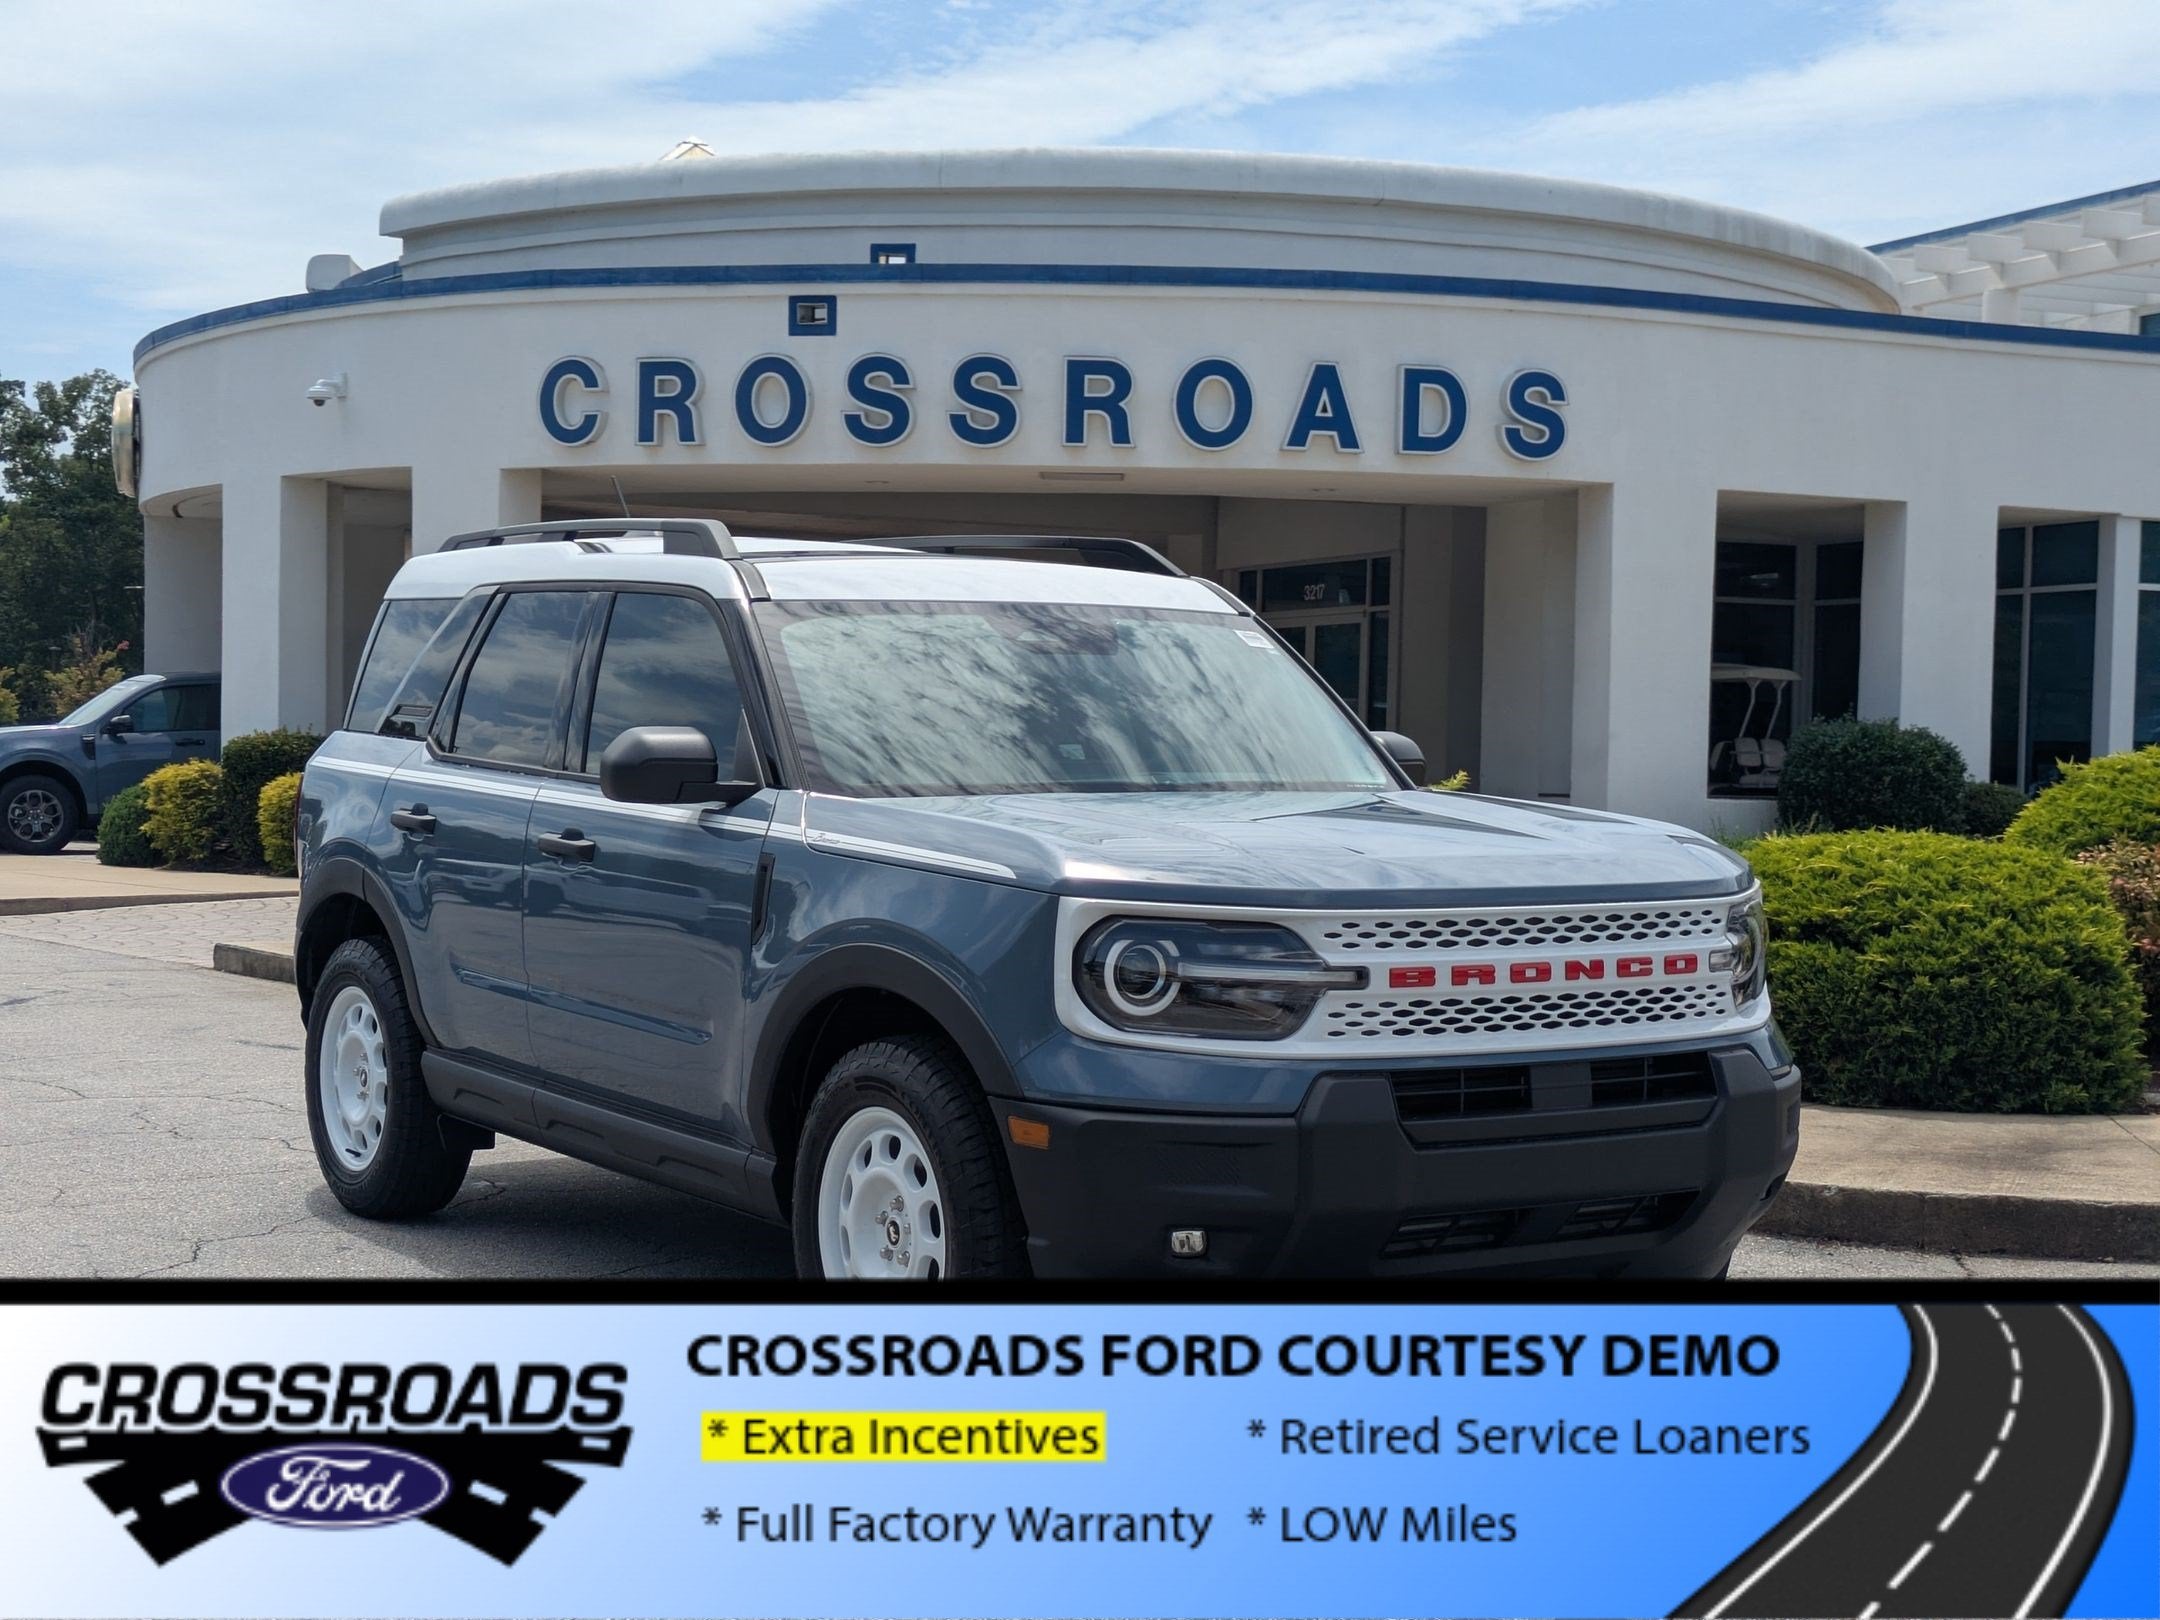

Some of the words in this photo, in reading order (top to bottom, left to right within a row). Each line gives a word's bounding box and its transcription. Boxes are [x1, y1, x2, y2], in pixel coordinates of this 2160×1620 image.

[539, 354, 1567, 461] CROSSROADS
[1304, 583, 1325, 601] 3217
[1389, 954, 1698, 988] BRONCO
